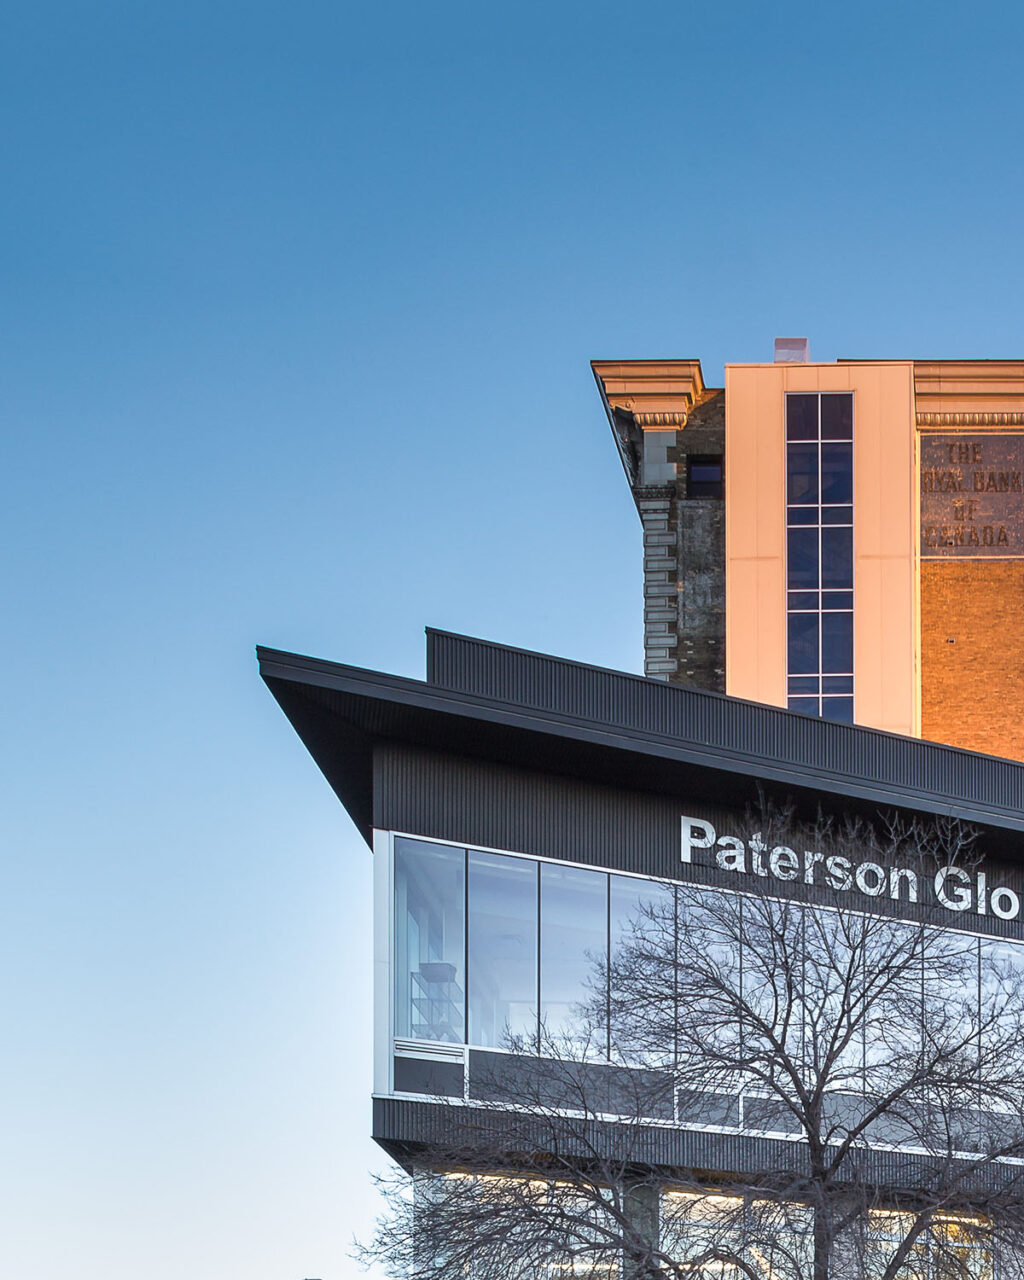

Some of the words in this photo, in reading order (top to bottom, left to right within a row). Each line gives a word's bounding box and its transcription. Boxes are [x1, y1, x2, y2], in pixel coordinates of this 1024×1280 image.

[946, 441, 983, 464] THE
[921, 470, 968, 493] OYAL
[973, 470, 1023, 493] BANK
[924, 524, 1010, 547] CANADA
[680, 815, 918, 903] Paterson
